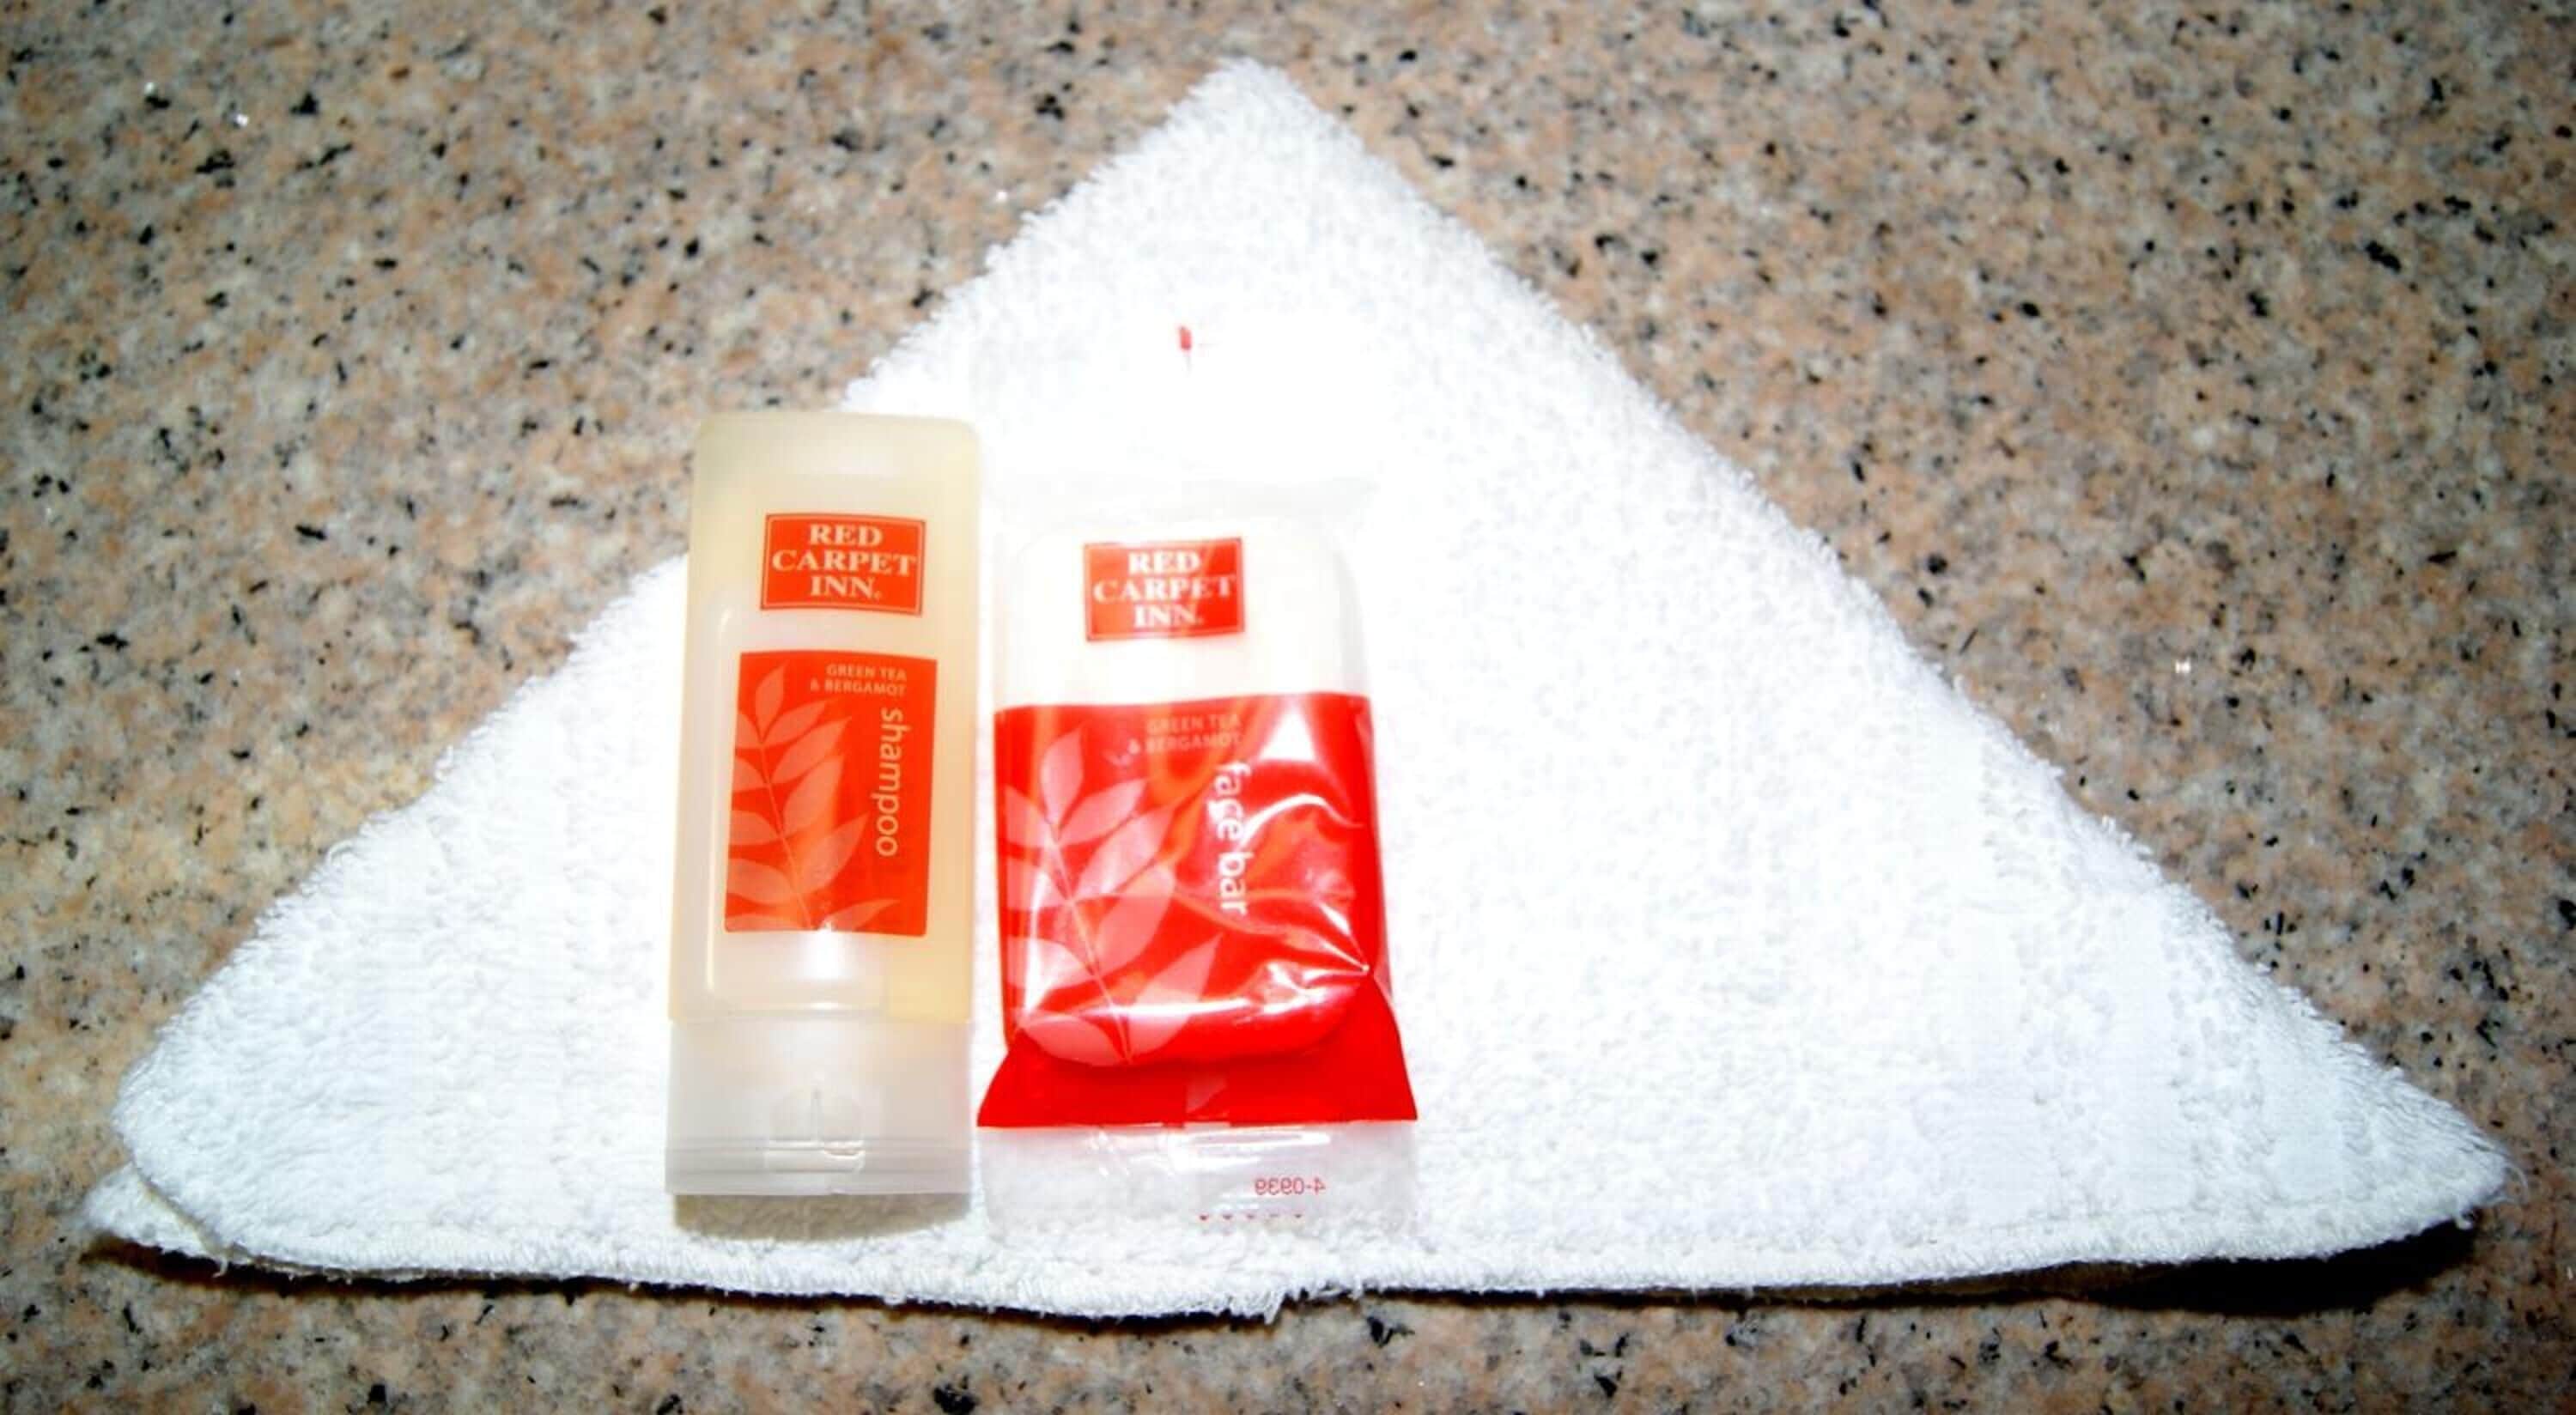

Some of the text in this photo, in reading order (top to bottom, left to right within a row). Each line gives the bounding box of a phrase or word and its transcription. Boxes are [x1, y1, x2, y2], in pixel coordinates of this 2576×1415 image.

[810, 524, 884, 547] RED
[772, 549, 917, 576] CARPET
[1128, 550, 1201, 574] RED
[1093, 574, 1236, 603] CARPET
[825, 664, 908, 681] GREEN TEA
[824, 678, 907, 697] BERGAMOT
[869, 707, 912, 857] shampoo
[1206, 761, 1255, 916] face bar
